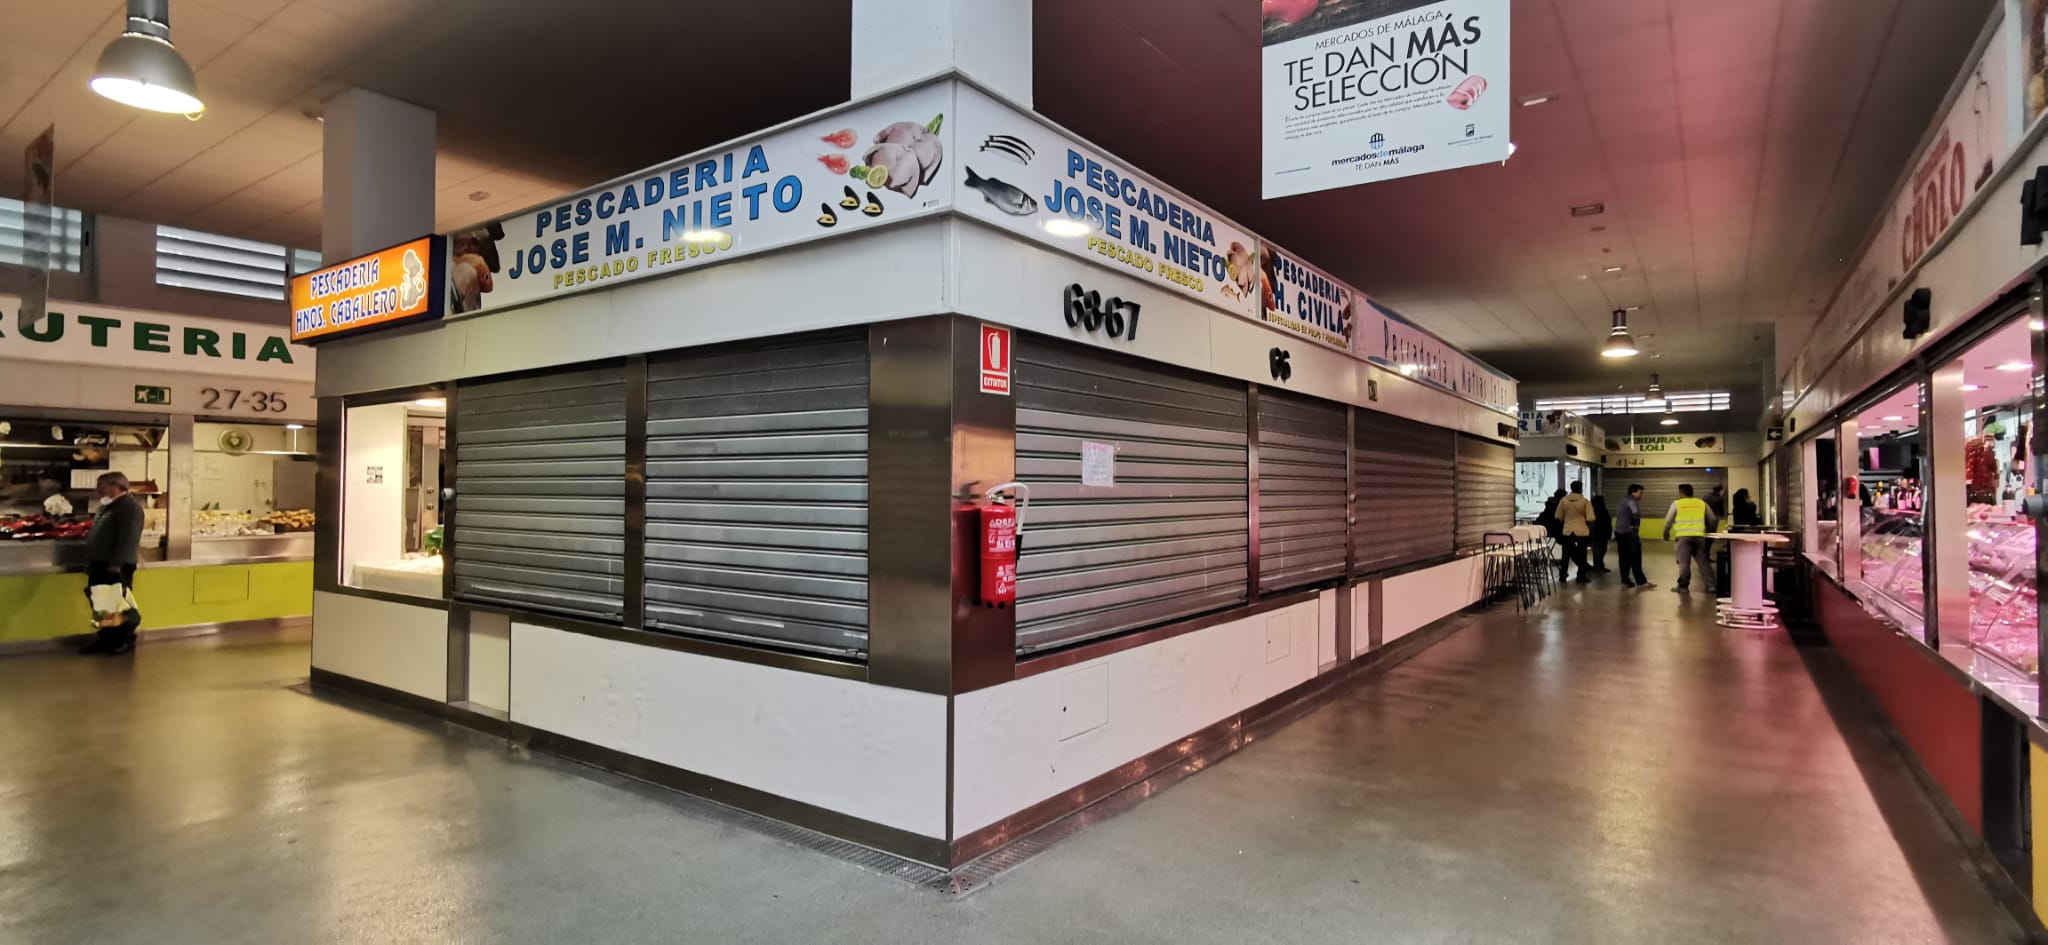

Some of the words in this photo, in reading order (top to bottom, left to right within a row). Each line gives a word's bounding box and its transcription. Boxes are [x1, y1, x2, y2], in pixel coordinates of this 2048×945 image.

[1284, 56, 1314, 86] TE
[1325, 36, 1395, 78] DAN
[1406, 13, 1481, 59] MÁS
[1315, 28, 1374, 50] MERCADOS
[1377, 23, 1390, 35] DE
[1393, 10, 1443, 31] MÁLAGA
[1294, 50, 1468, 111] SELECCIÓN
[536, 145, 769, 238] PESCADERIA
[1068, 149, 1216, 246] PESCADERIA
[509, 231, 590, 279] JOSE
[606, 222, 643, 256] M.
[663, 175, 802, 241] NIETO
[1044, 180, 1122, 239] JOSE
[1130, 215, 1157, 254] M.
[1164, 230, 1226, 283] NIETO
[311, 257, 379, 298] PESCADERIA
[553, 255, 639, 289] PESCADO
[648, 233, 733, 268] FRESCO
[1088, 237, 1153, 272] PESCADO
[1159, 263, 1204, 292] FRESCO
[1275, 255, 1341, 305] PESCADERIA
[0, 309, 294, 364] UTERIA
[296, 305, 326, 334] HNOS.
[331, 288, 397, 324] CABALLERO
[200, 387, 288, 413] 27-35
[984, 376, 1008, 389] EXTINTOR
[1622, 436, 1683, 445] VERDURAS
